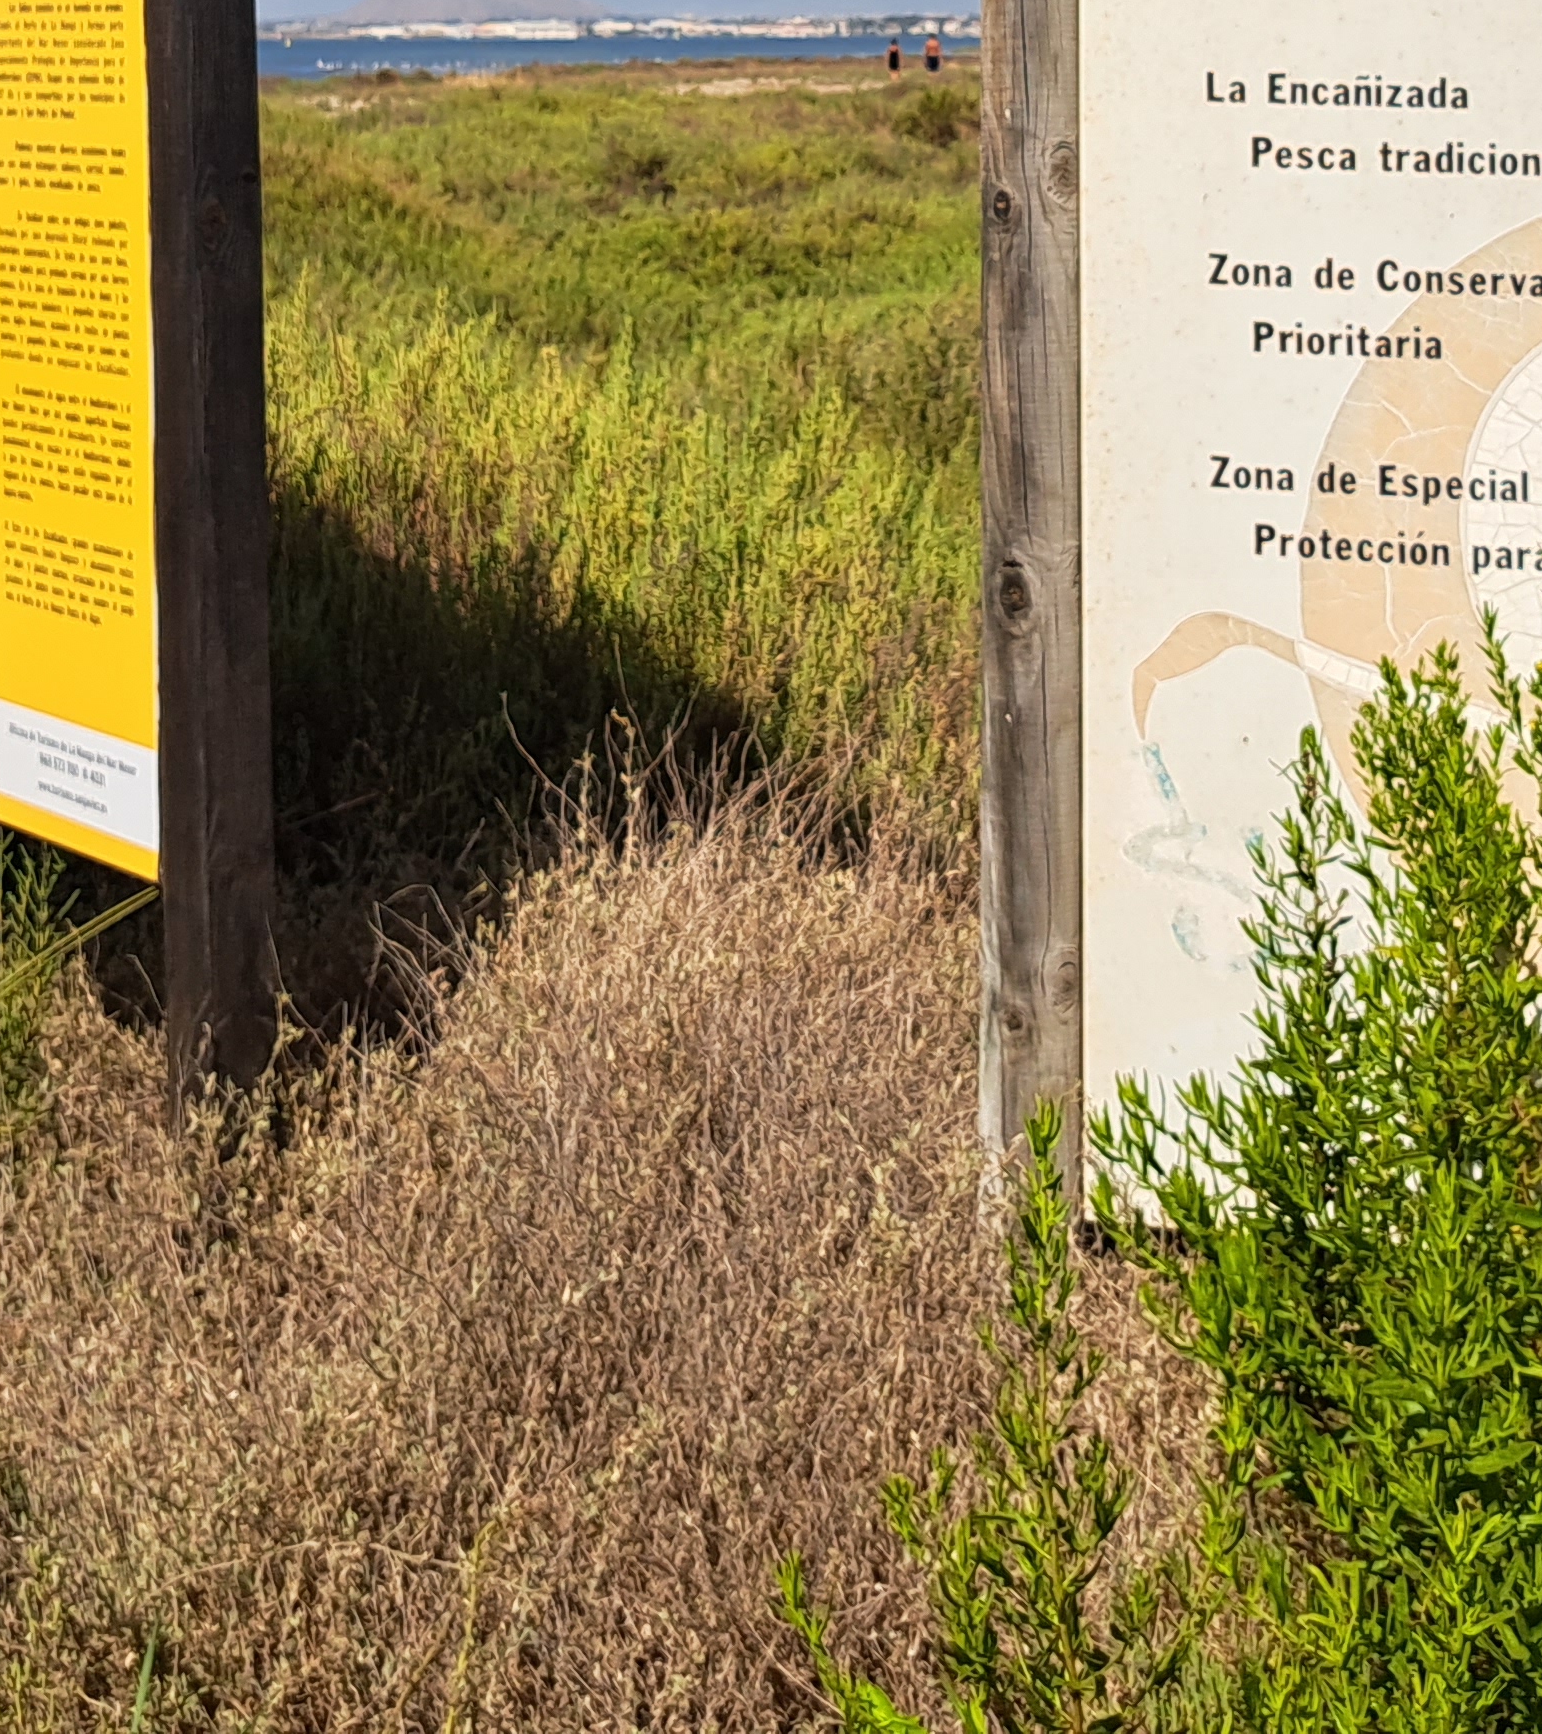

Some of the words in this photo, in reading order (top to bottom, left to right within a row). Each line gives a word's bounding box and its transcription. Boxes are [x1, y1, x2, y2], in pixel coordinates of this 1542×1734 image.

[1206, 72, 1247, 104] La
[1268, 73, 1470, 111] Encañizada
[1251, 137, 1358, 172] Pesca
[1208, 253, 1294, 289] Zona
[1314, 258, 1356, 292] de
[1252, 322, 1444, 360] Prioritaria
[1210, 456, 1295, 493] Zona
[1316, 463, 1358, 497] de
[1378, 465, 1531, 506] Especial
[1254, 524, 1451, 568] Protección
